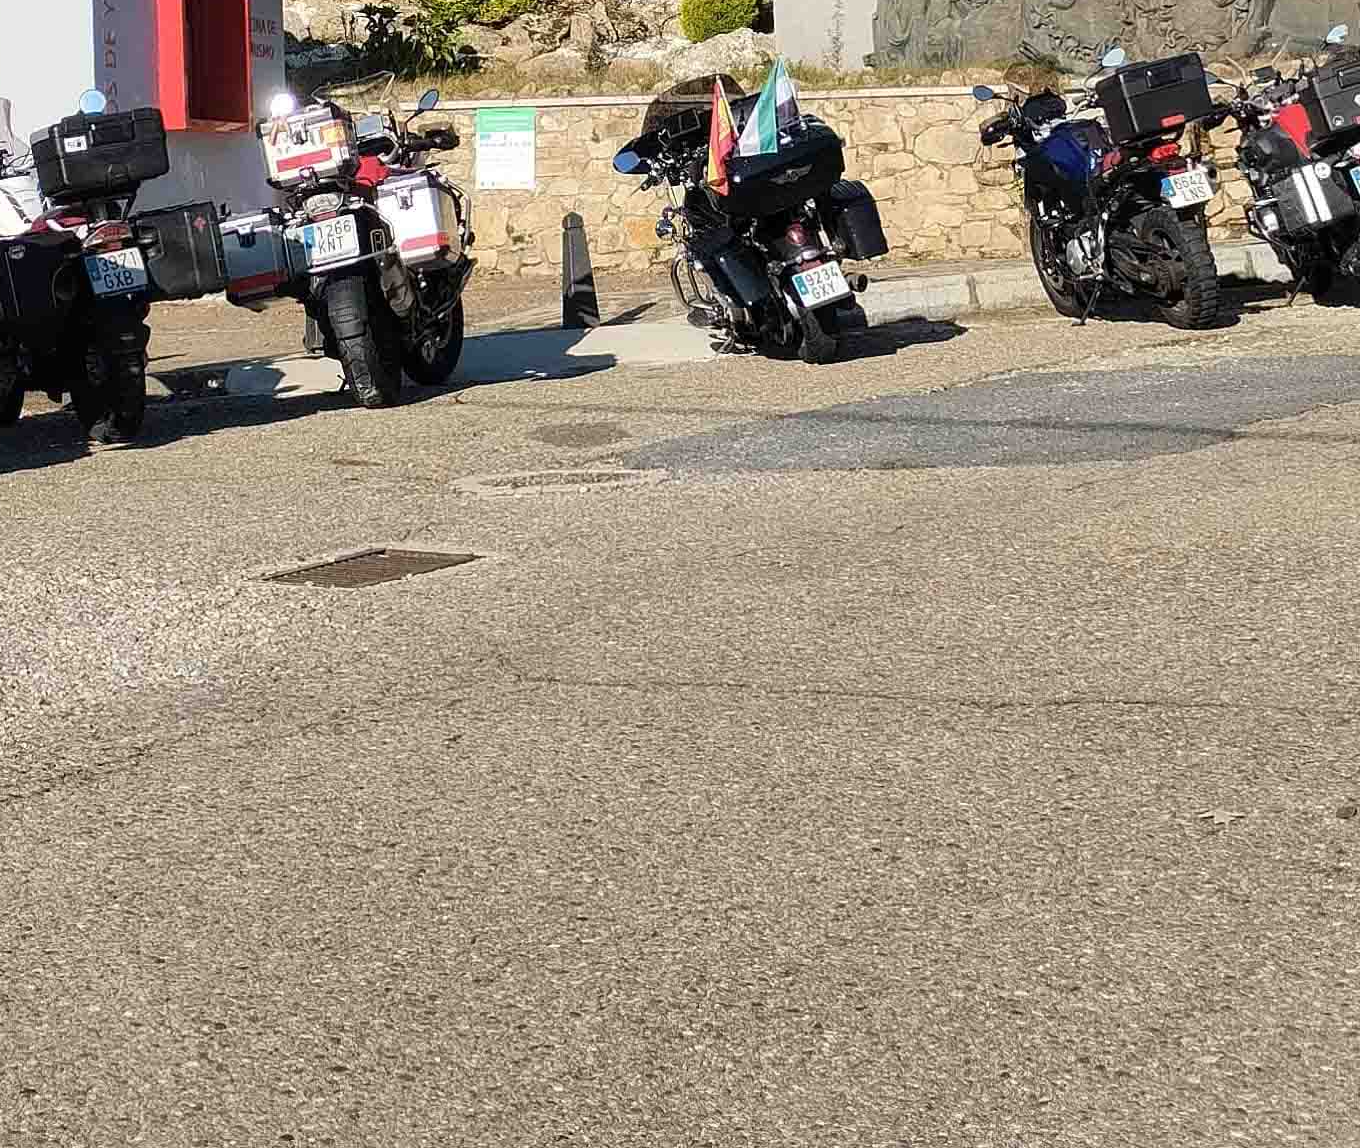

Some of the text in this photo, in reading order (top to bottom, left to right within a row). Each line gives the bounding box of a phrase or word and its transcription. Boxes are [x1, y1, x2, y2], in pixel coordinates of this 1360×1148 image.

[104, 30, 117, 69] DE
[1173, 172, 1202, 190] 6642
[317, 219, 352, 239] 1266
[319, 235, 344, 254] KNT
[98, 251, 137, 272] 3971
[103, 269, 134, 289] GXB
[805, 265, 839, 286] 9234
[811, 280, 836, 299] GXY
